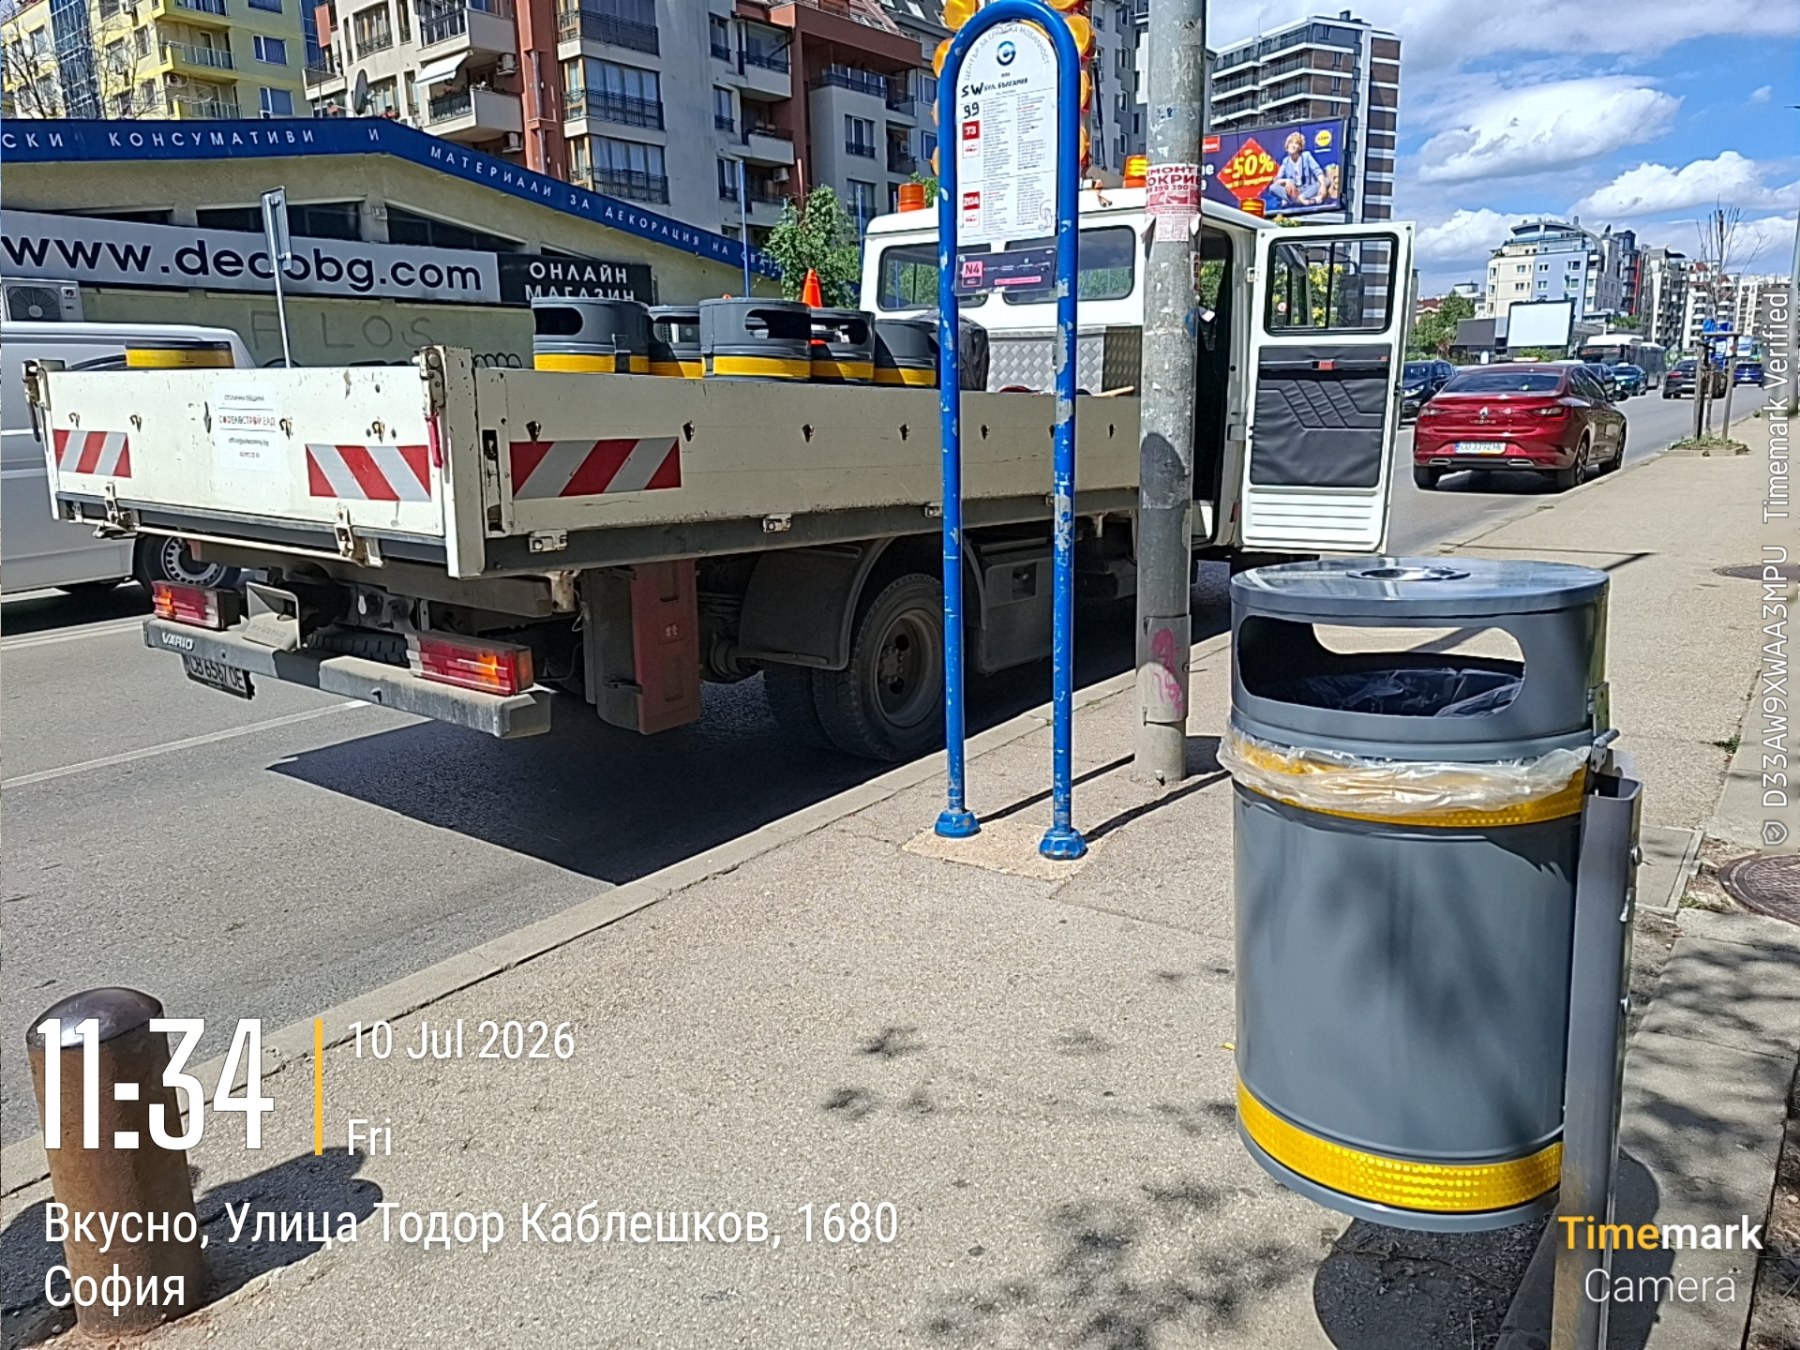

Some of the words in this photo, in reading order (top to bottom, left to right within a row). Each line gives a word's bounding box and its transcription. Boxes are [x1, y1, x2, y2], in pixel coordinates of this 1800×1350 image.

[109, 129, 314, 147] КОНСУМАТИВИ
[368, 129, 380, 141] И
[431, 146, 551, 197] МАТЕРИАЛИ
[570, 194, 590, 210] ЗА
[605, 205, 700, 245] ДЕКОРАЦИЯ
[712, 242, 729, 255] НА
[0, 236, 481, 292] www.decobg.com
[529, 262, 627, 284] ОНЛАЙН
[965, 263, 980, 275] N4
[525, 284, 634, 302] МАГАЗИН
[161, 632, 194, 651] VARIO
